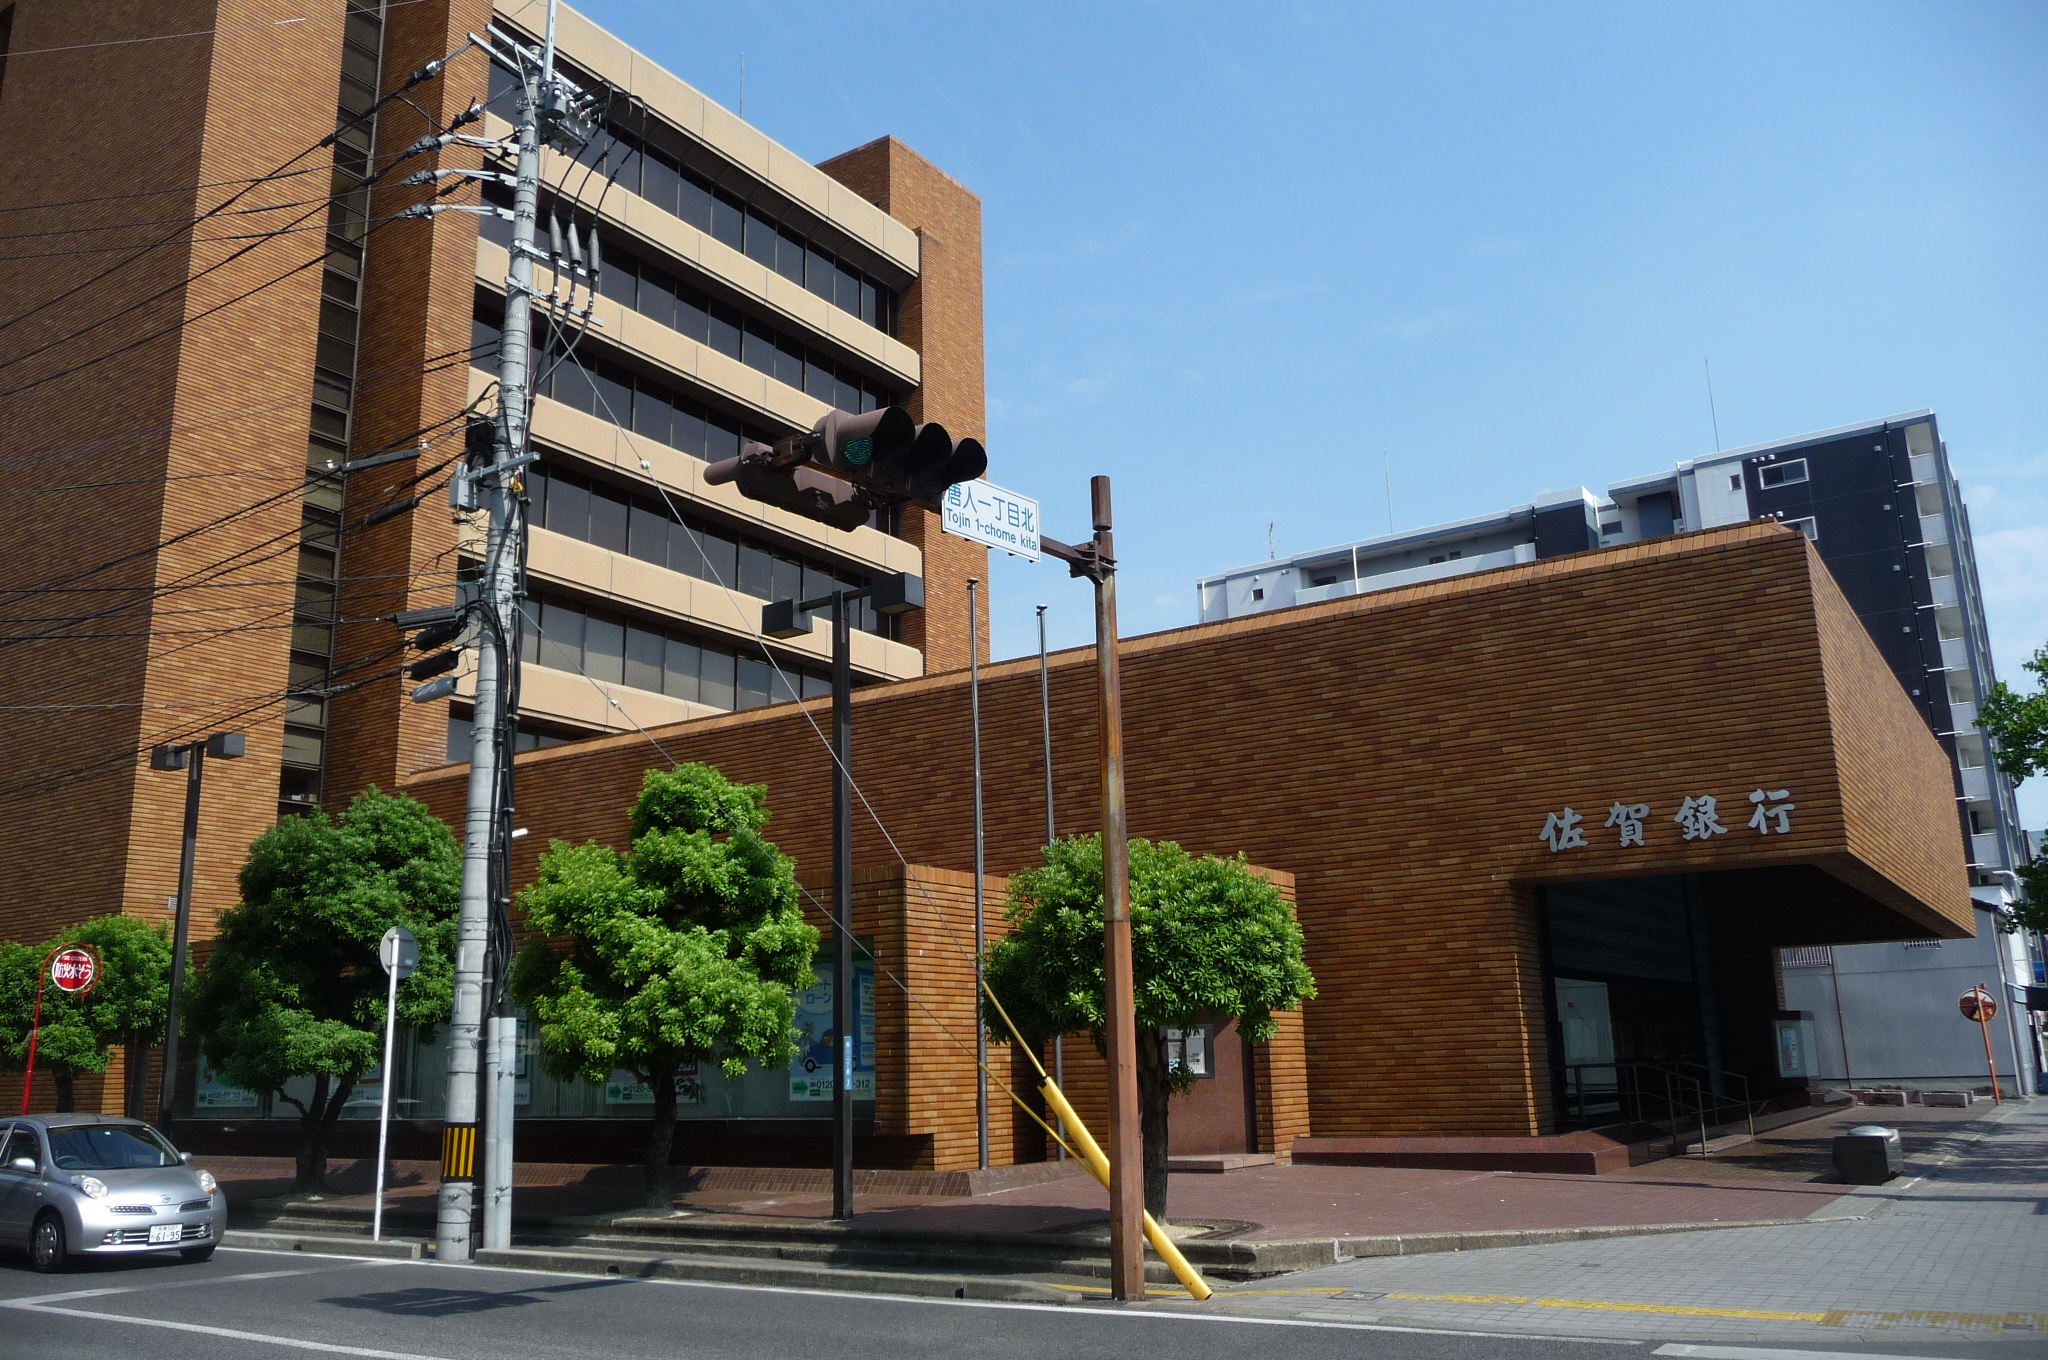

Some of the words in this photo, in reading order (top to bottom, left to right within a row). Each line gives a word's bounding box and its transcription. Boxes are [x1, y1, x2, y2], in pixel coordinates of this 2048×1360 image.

[947, 483, 1035, 533] 唐人一丁目北
[946, 507, 971, 529] Tojin
[975, 518, 1016, 545] 1-chome
[1020, 533, 1037, 551] kita
[1539, 788, 1796, 853] 佐賀銀行
[55, 962, 92, 979] 防火水そう
[806, 993, 832, 1004] ローン
[155, 1231, 180, 1241] 61-95
